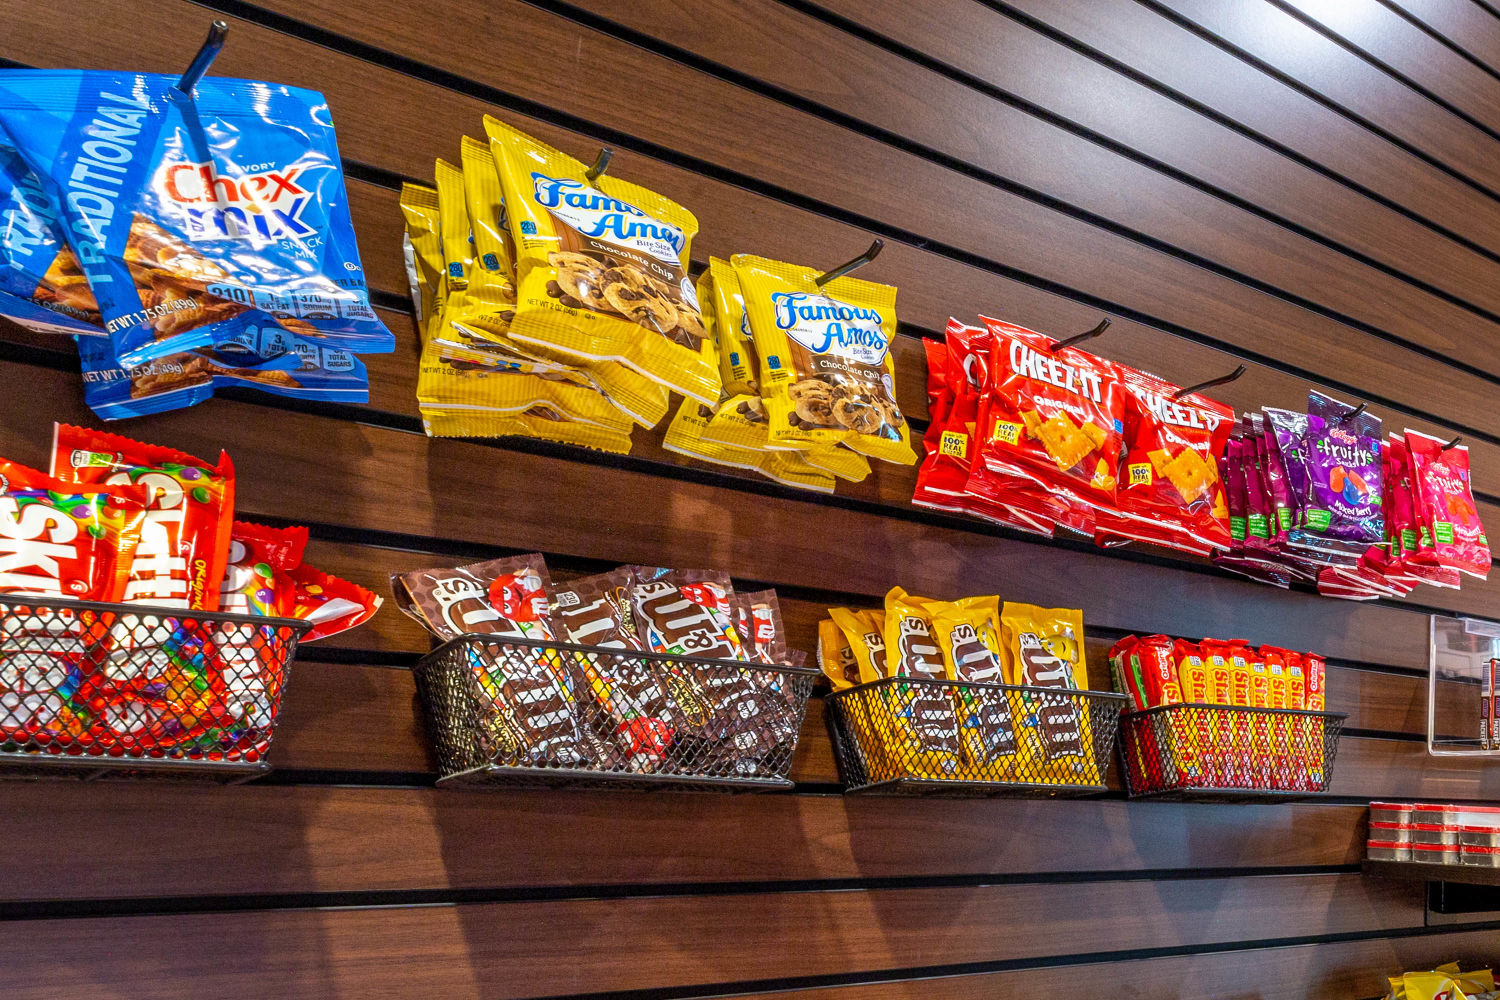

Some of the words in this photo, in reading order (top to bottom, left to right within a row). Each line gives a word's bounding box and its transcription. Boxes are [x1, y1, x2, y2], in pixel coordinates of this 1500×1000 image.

[67, 91, 151, 291] TRADITIONAL
[165, 164, 303, 203] Chex
[590, 240, 649, 267] Chocolate
[651, 263, 674, 281] Chip
[771, 291, 882, 330] Famous
[812, 322, 887, 354] Amos
[820, 359, 862, 378] Chocolate
